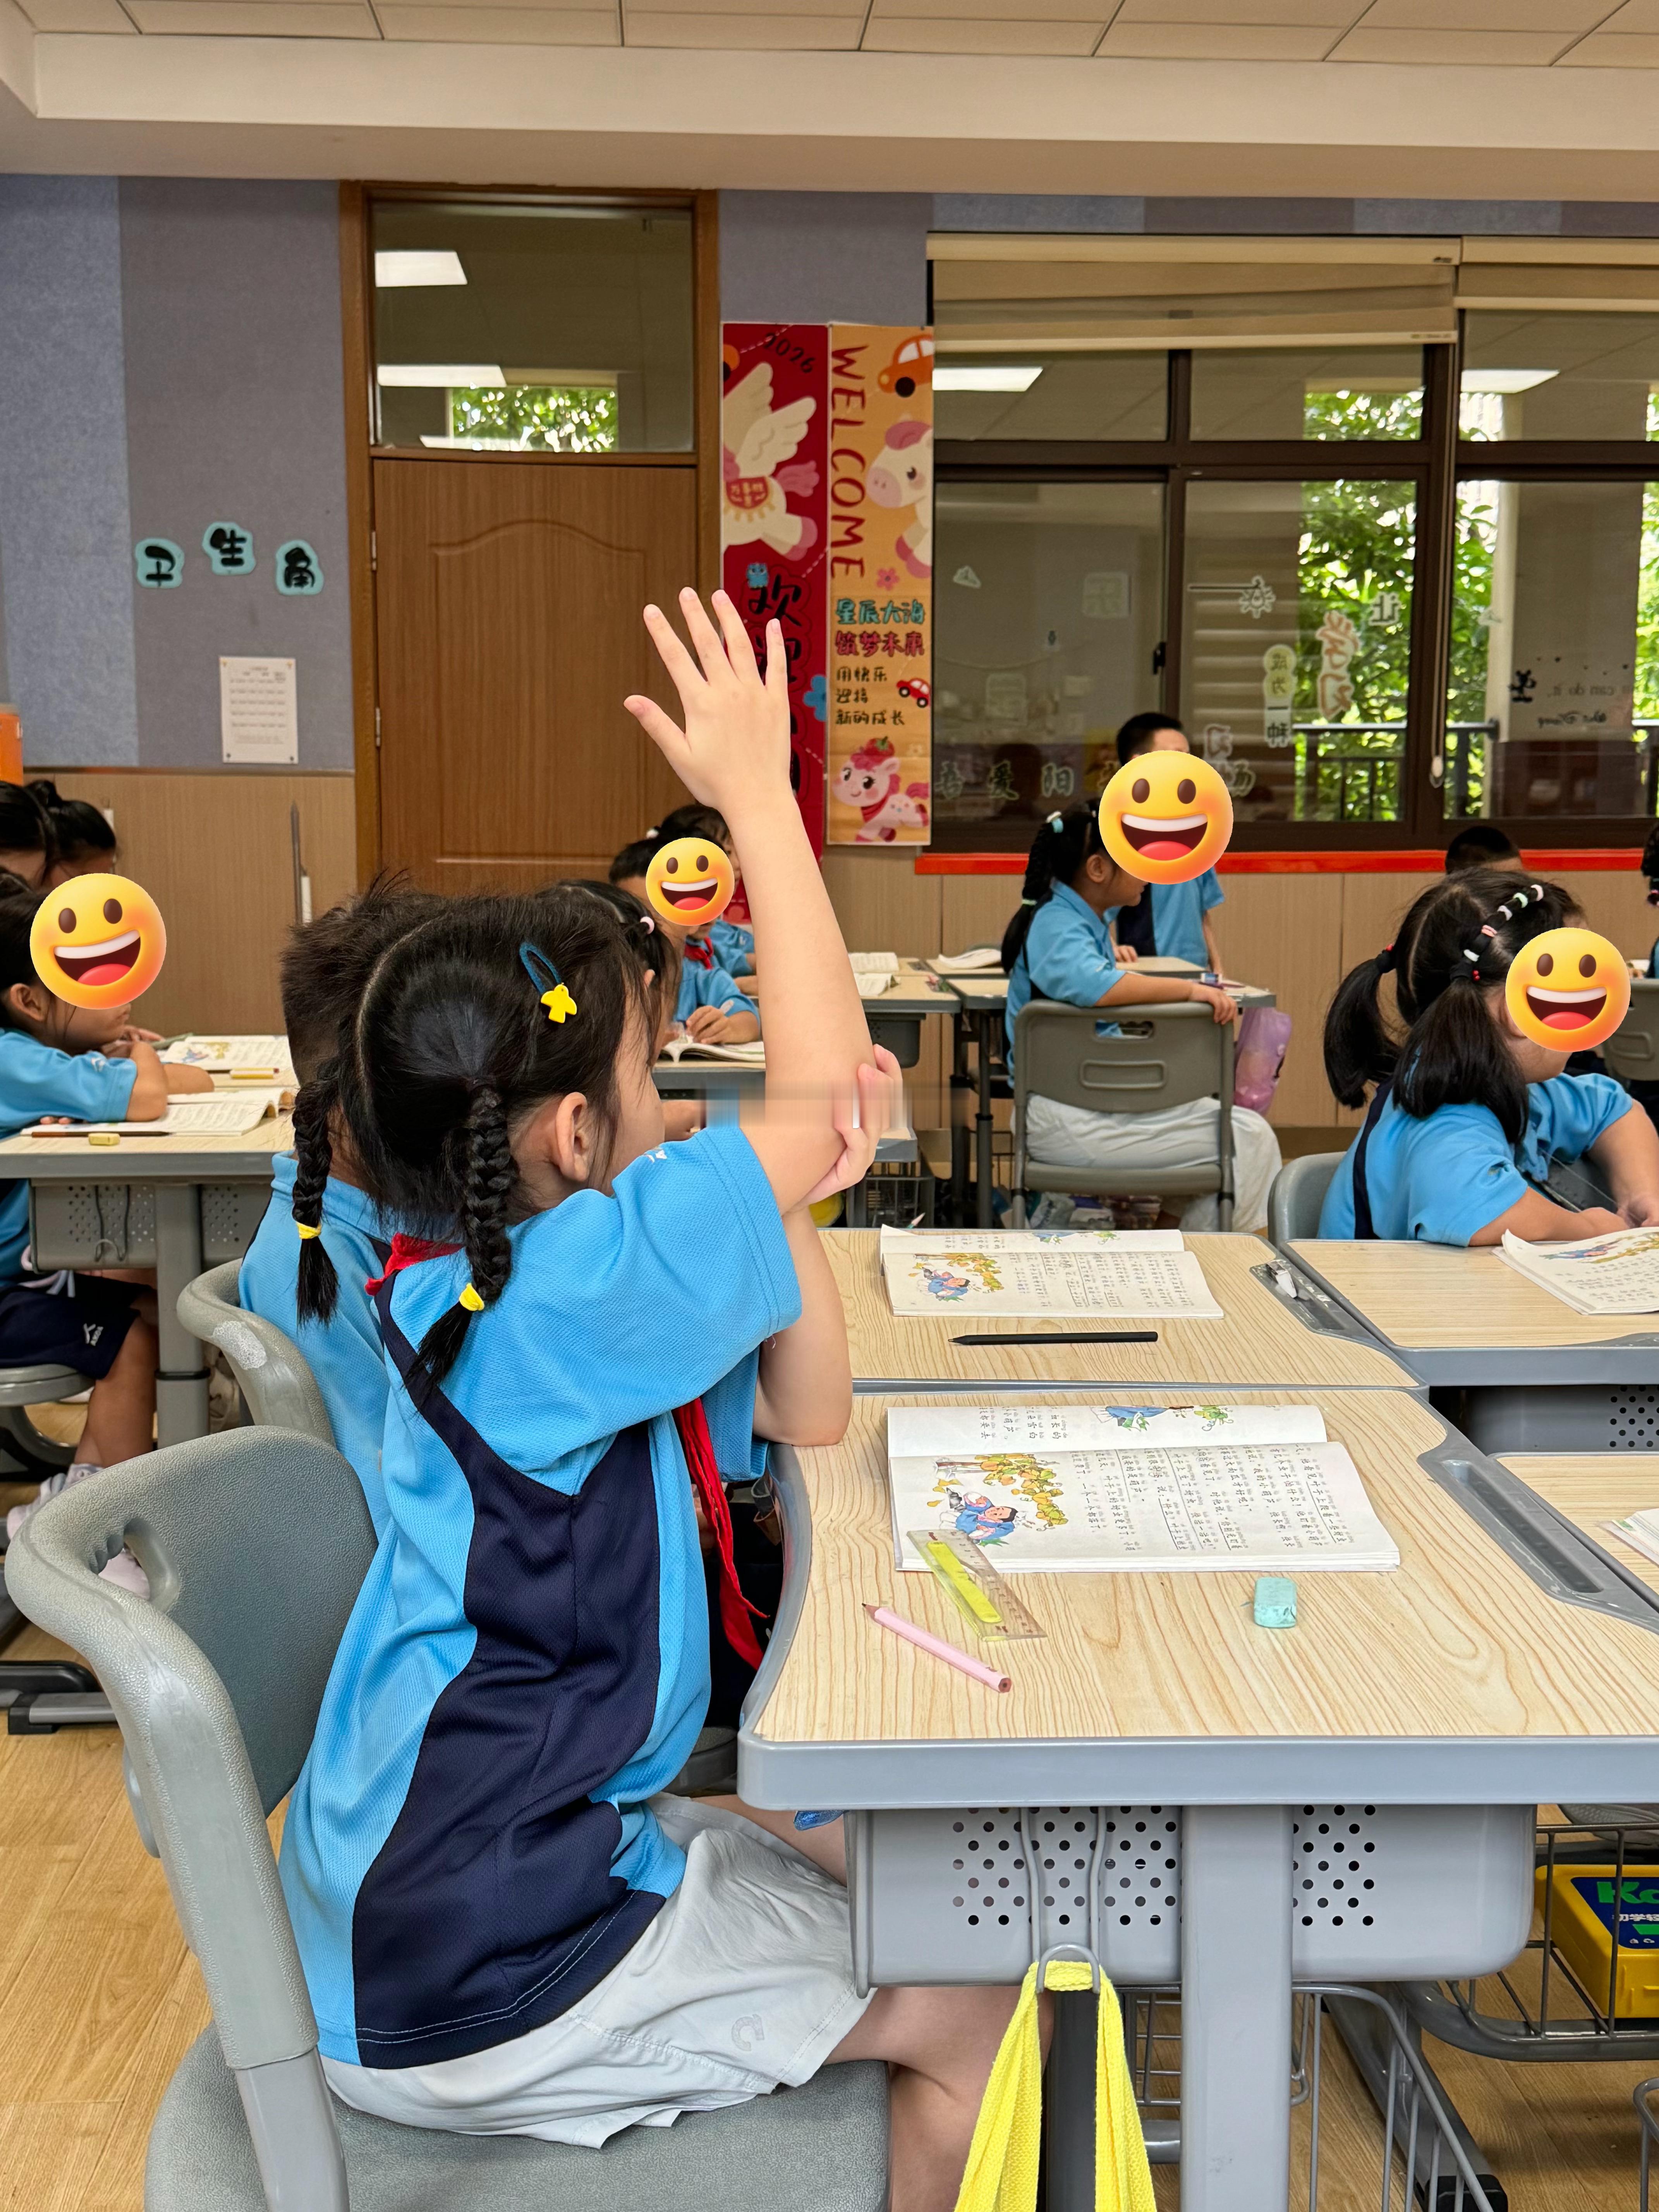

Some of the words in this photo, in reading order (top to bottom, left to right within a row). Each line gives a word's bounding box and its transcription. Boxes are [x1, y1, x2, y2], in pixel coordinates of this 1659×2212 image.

[763, 332, 816, 373] 2026
[831, 345, 869, 579] WELCOME
[145, 528, 315, 588] 卫生角
[835, 598, 926, 625] 星辰大海
[836, 666, 888, 682] 用快乐
[836, 688, 869, 704] 迎接
[836, 709, 905, 725] 新的成长
